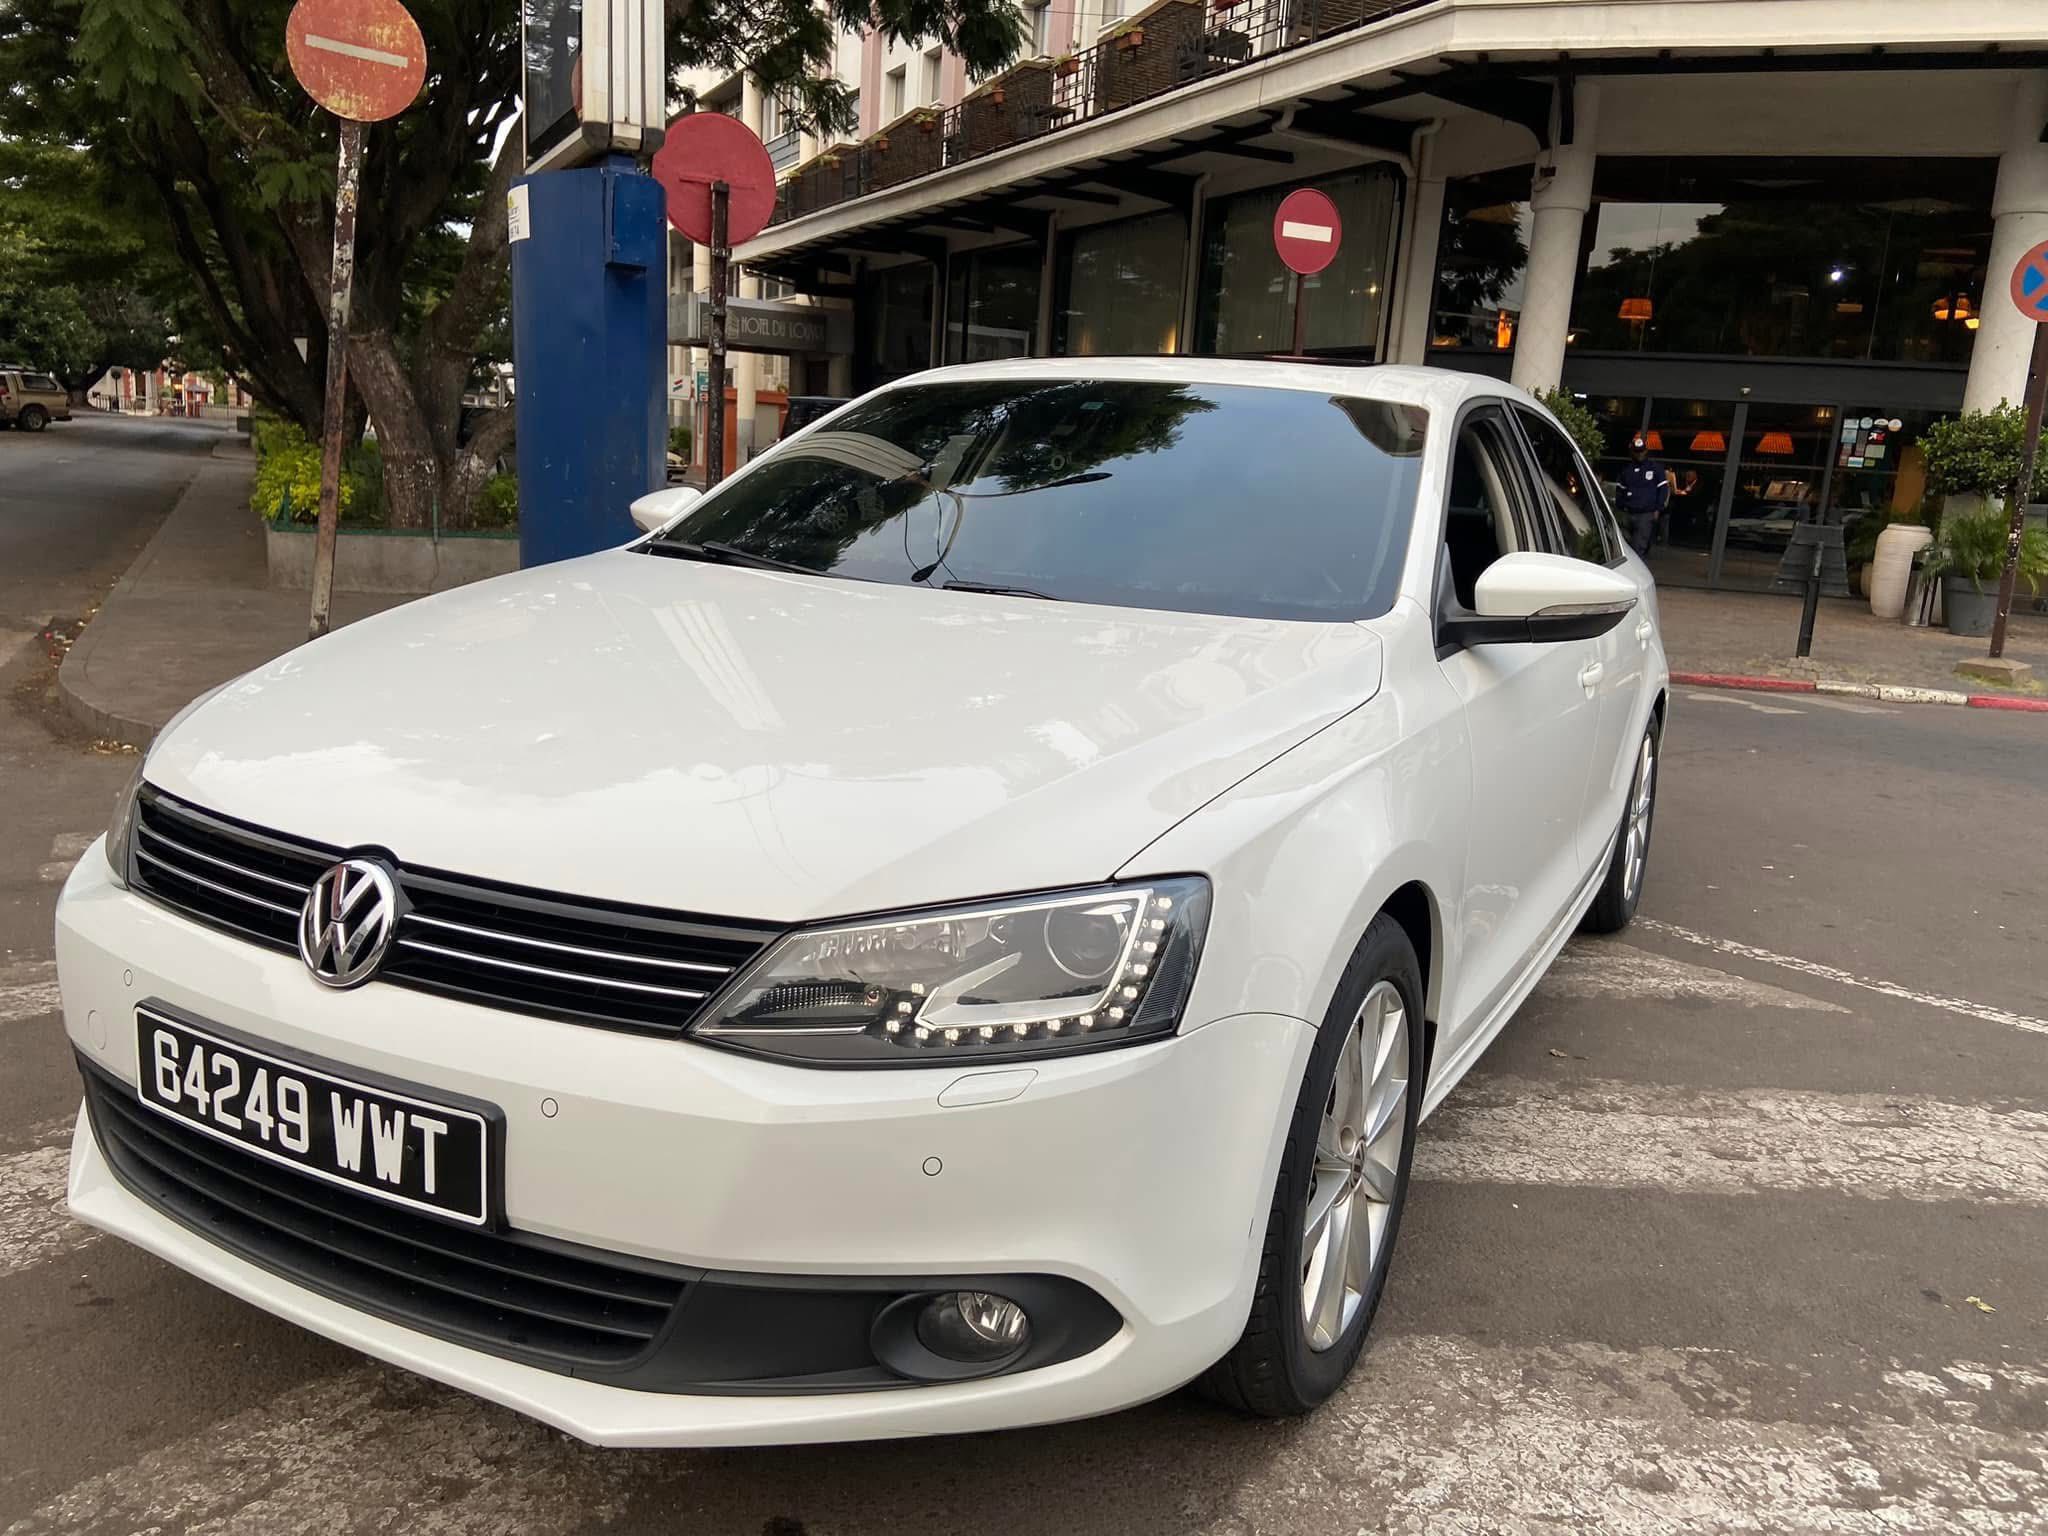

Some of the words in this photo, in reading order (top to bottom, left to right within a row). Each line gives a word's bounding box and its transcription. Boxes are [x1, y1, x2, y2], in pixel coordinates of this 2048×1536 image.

[741, 316, 771, 336] HOTEL
[152, 1028, 310, 1155] 64249
[330, 1091, 448, 1195] WWT
